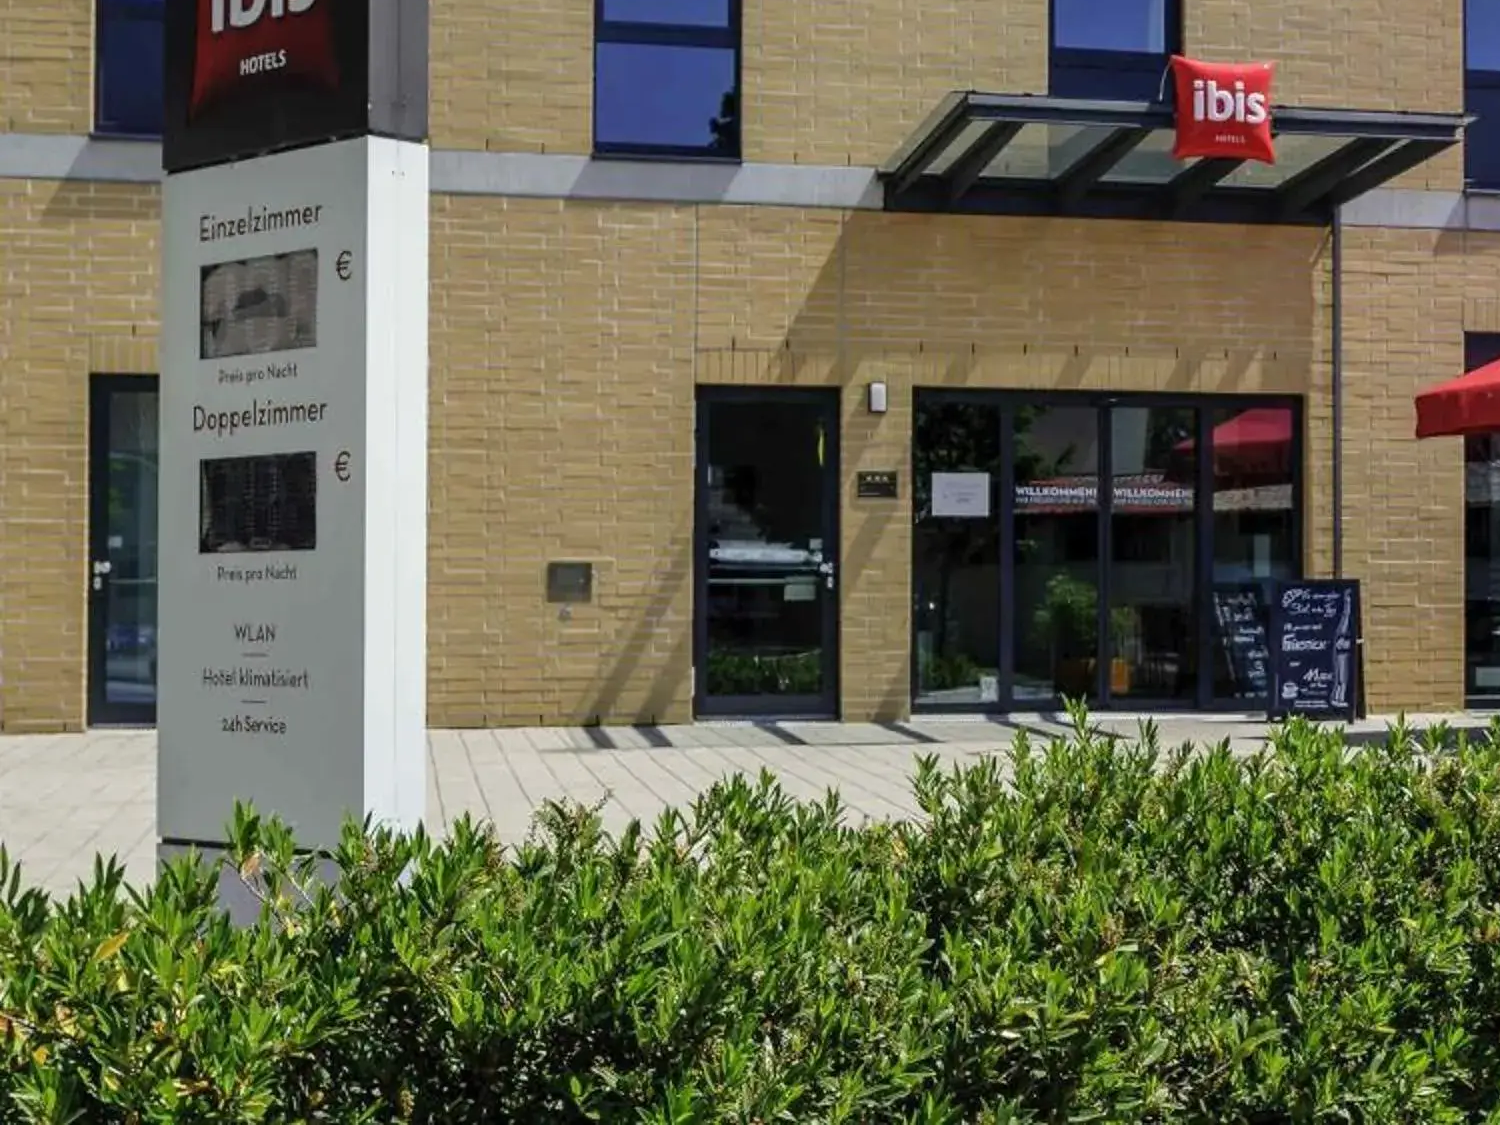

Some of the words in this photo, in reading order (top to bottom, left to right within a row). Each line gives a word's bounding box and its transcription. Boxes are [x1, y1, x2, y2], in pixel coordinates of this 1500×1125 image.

[240, 49, 287, 76] HOTELS
[1193, 79, 1267, 124] ibis
[200, 204, 323, 242] Einzelzimmer
[335, 250, 352, 281] €
[217, 368, 243, 384] Preis
[245, 370, 265, 385] pro
[267, 363, 298, 379] Nacht
[193, 398, 328, 437] Doppelzimmer
[335, 450, 351, 482] €
[217, 566, 242, 582] Preis
[245, 569, 263, 584] pro
[265, 564, 298, 580] Nacht
[233, 624, 276, 642] WLAN
[202, 667, 236, 687] Hotel
[239, 666, 310, 689] klimatisiert
[221, 714, 243, 733] 24h
[244, 715, 287, 735] Service
